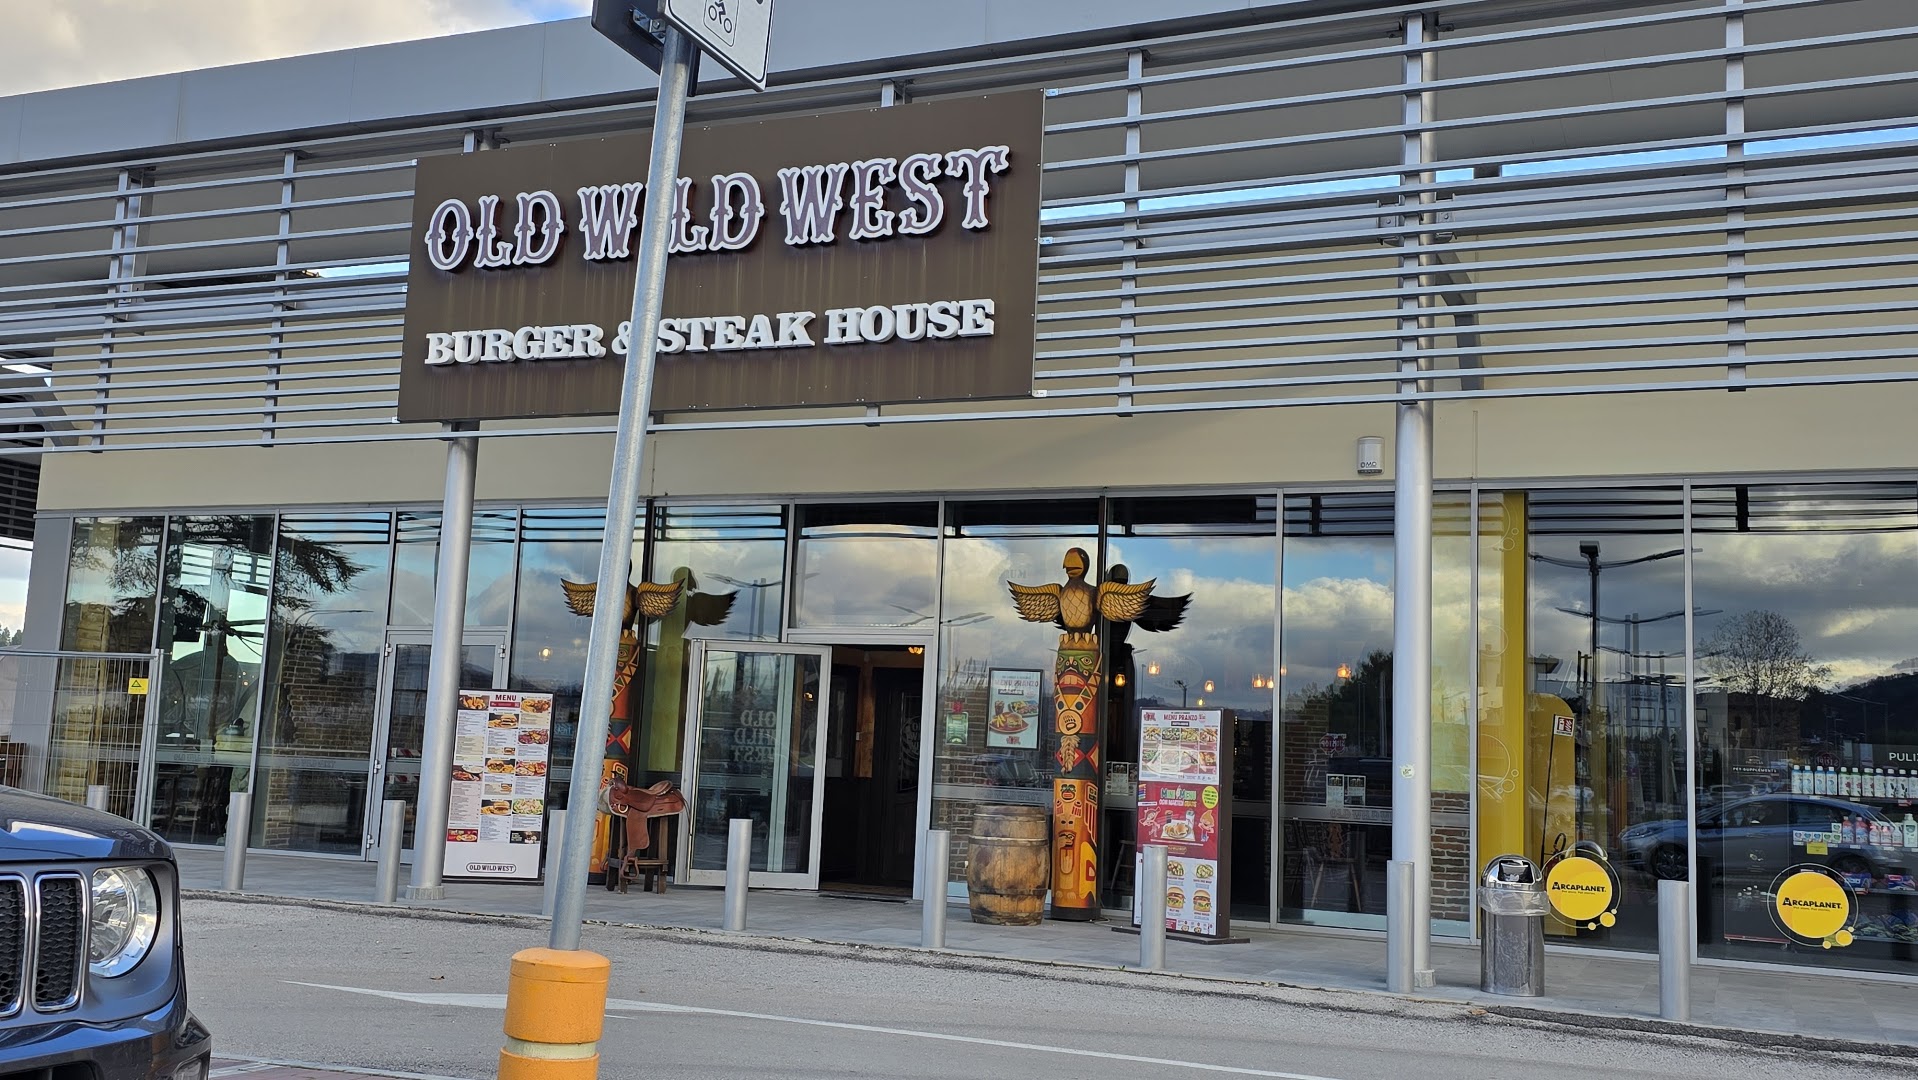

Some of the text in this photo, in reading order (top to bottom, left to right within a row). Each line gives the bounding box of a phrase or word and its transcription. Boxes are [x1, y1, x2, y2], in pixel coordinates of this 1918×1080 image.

[424, 145, 1010, 270] OLD WLD WEST
[424, 298, 995, 365] BURGER & STEAK HOUSE
[495, 694, 517, 702] MENU
[1888, 752, 1918, 762] PULI
[497, 864, 514, 872] WEST
[1551, 881, 1606, 893] ARCAPLANET
[1782, 897, 1842, 910] ARCAPLANET
